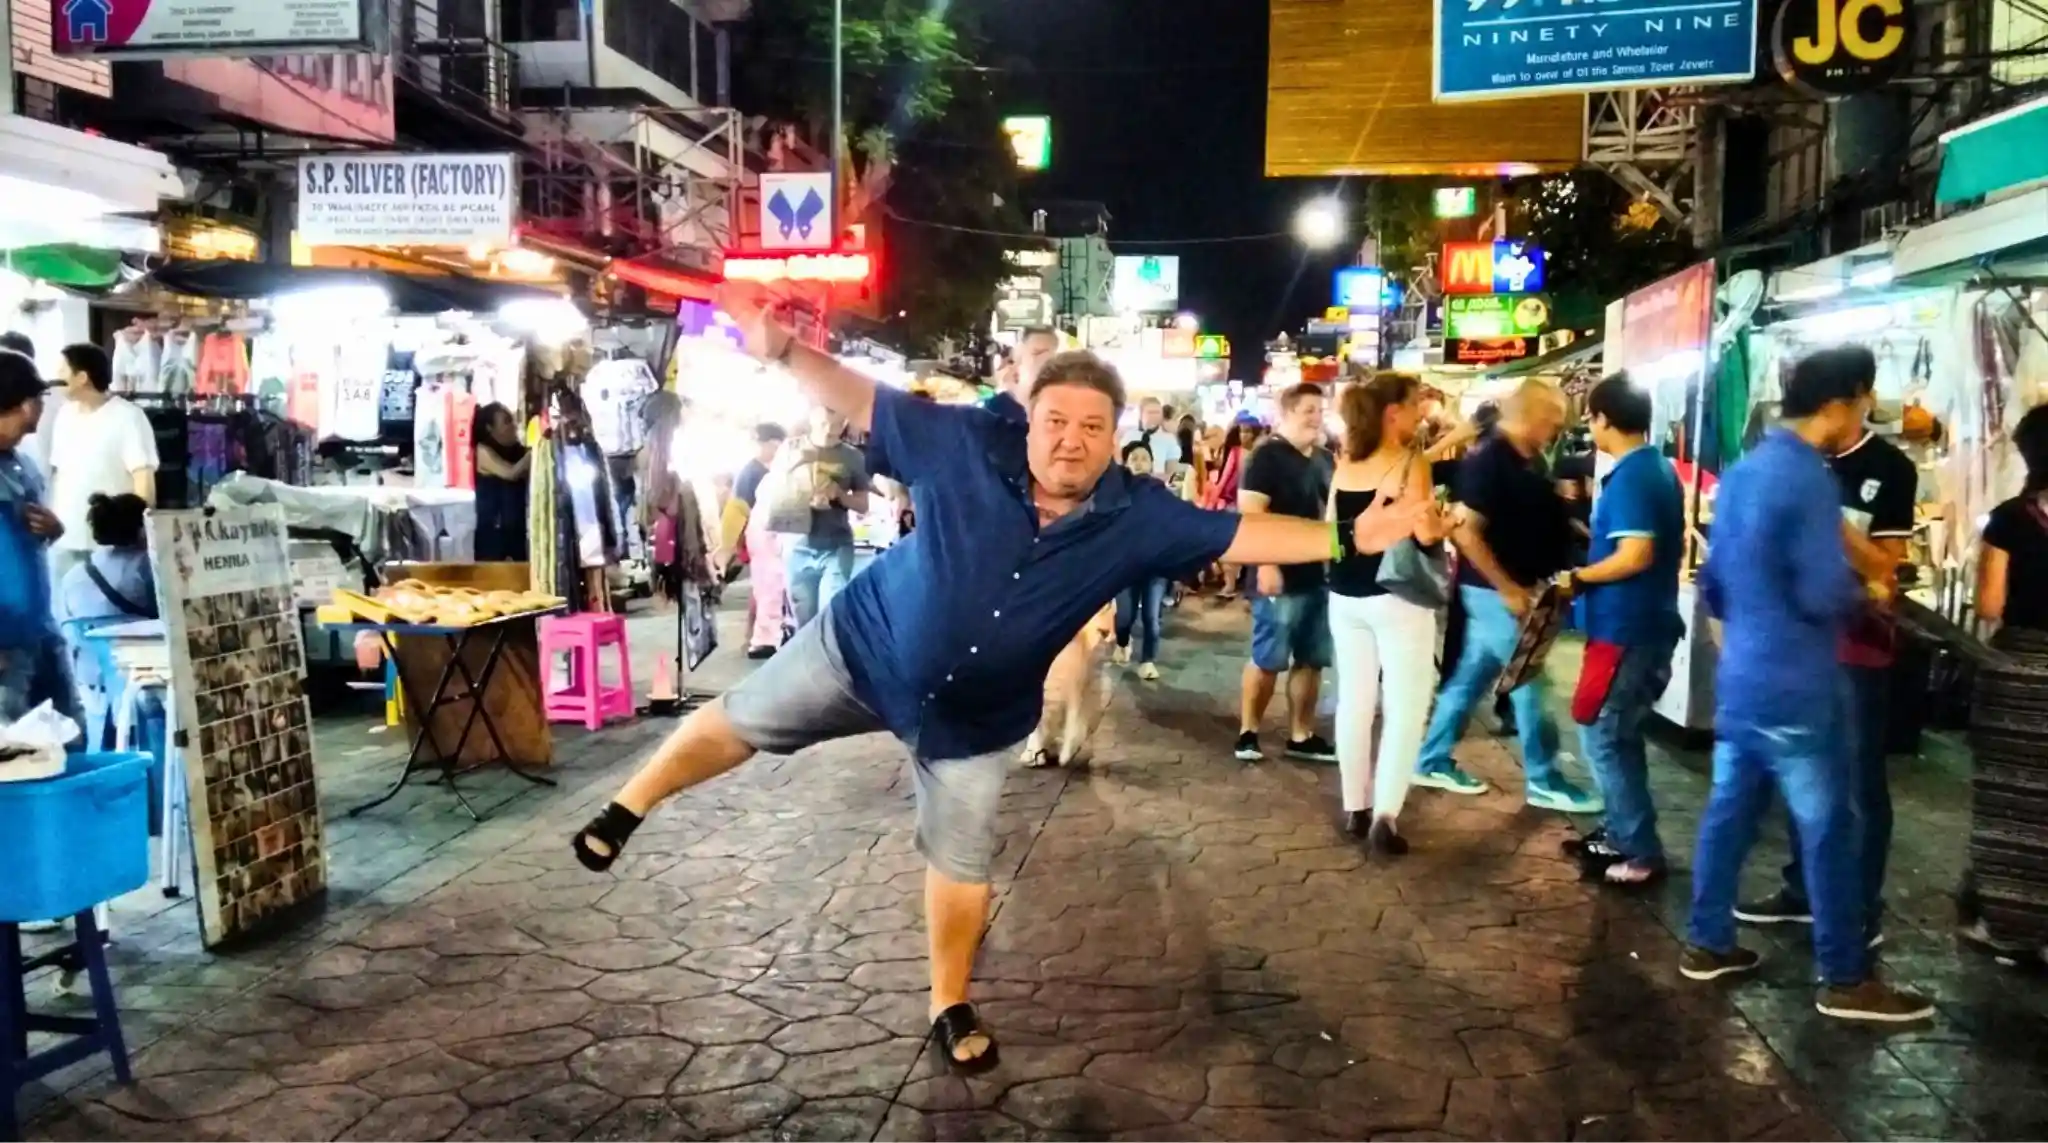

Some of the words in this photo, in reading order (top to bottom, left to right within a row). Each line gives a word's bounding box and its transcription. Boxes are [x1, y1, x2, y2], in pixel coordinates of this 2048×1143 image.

[1463, 24, 1608, 47] NINETY
[1645, 13, 1740, 33] NINE
[1793, 0, 1905, 64] JC
[306, 161, 338, 194] S.P.
[344, 162, 406, 195] SILVER
[410, 163, 505, 199] (FACTORY)
[203, 554, 250, 571] HENNA
